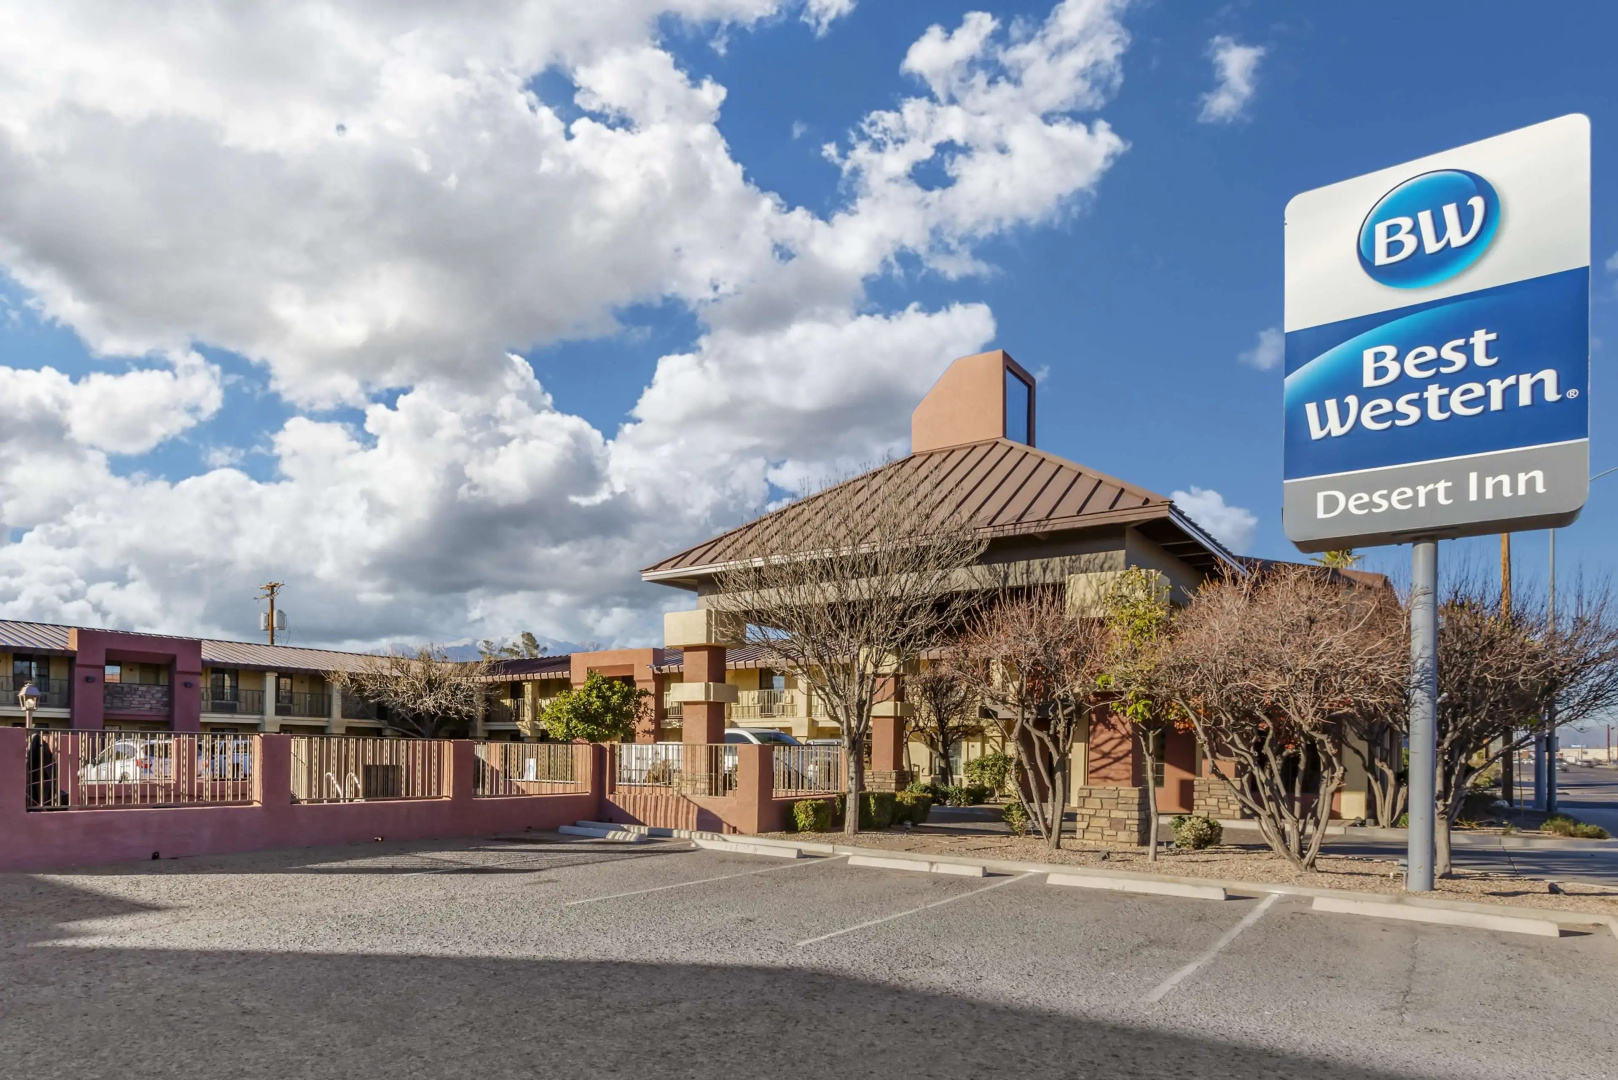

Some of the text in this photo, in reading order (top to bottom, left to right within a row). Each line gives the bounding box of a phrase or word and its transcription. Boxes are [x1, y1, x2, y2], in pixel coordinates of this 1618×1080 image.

[1374, 196, 1486, 267] BW
[1362, 329, 1499, 388] Best
[1316, 468, 1547, 519] Desert Inn
